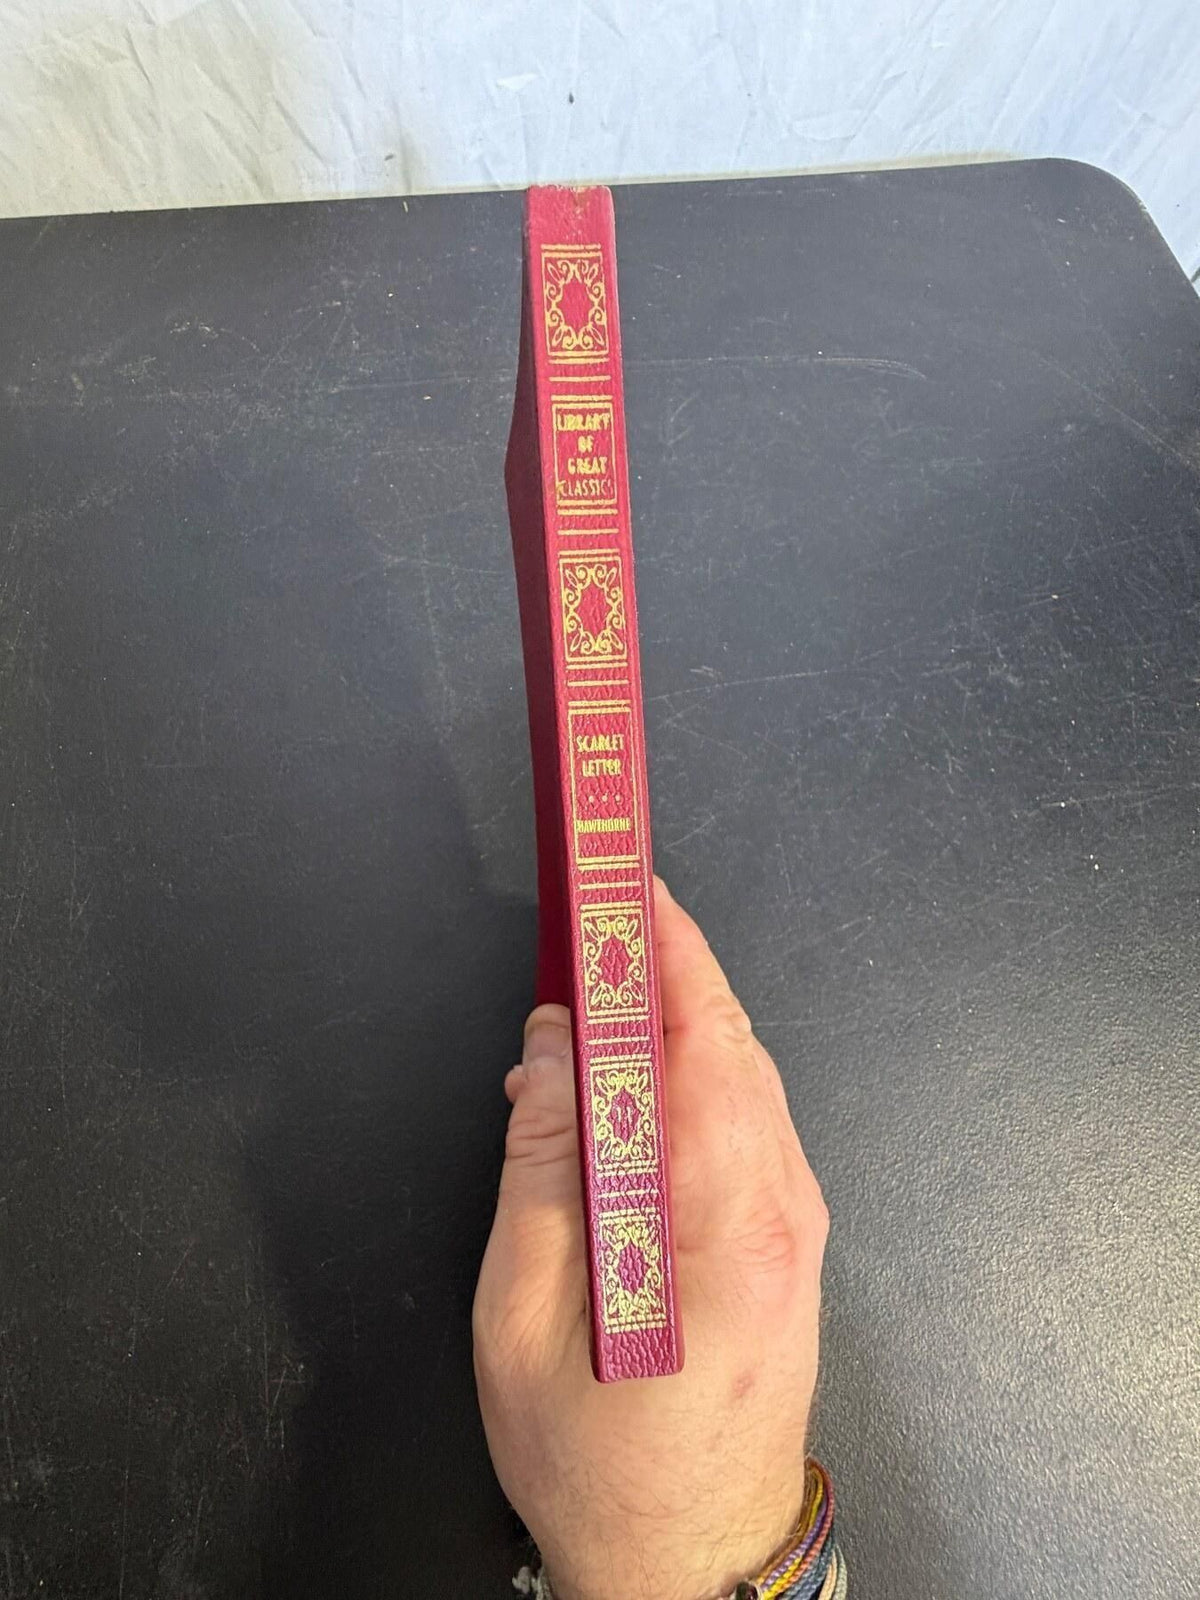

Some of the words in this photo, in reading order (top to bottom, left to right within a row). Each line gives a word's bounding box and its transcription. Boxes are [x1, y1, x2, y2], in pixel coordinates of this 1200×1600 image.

[577, 435, 594, 453] OF
[567, 456, 607, 474] GREAT
[575, 733, 624, 752] SCARLET
[582, 759, 622, 777] LETTER
